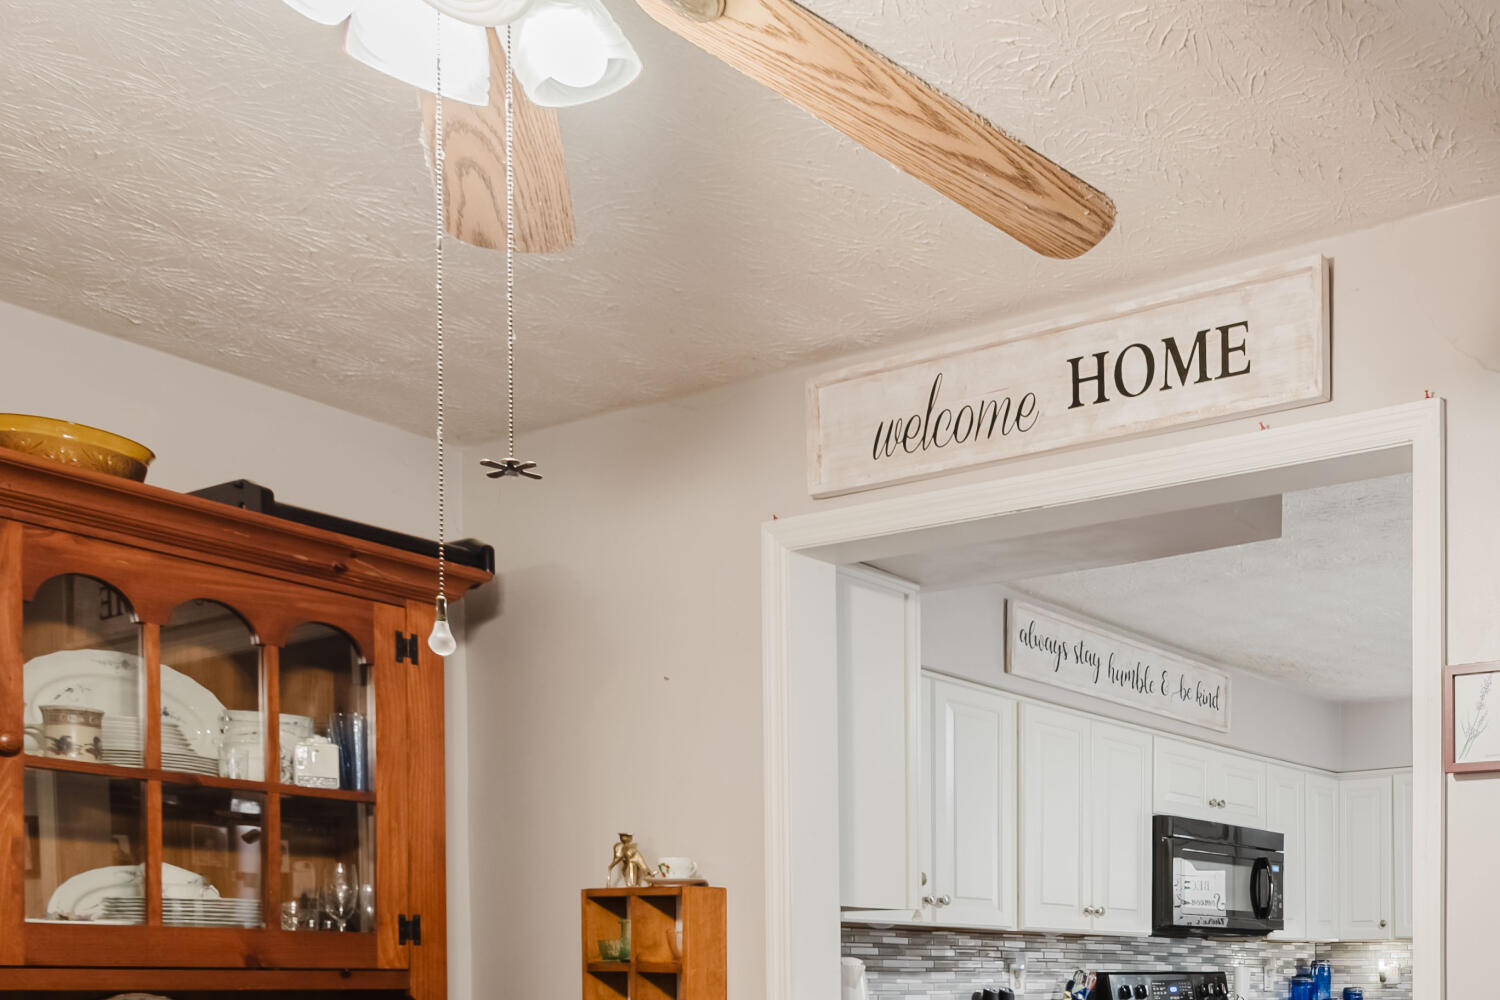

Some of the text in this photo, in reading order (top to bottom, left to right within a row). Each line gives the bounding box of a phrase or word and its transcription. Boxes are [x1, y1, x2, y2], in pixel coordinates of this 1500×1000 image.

[872, 320, 1252, 462] welcome HOME
[1019, 620, 1221, 711] always stay humble & be kind
